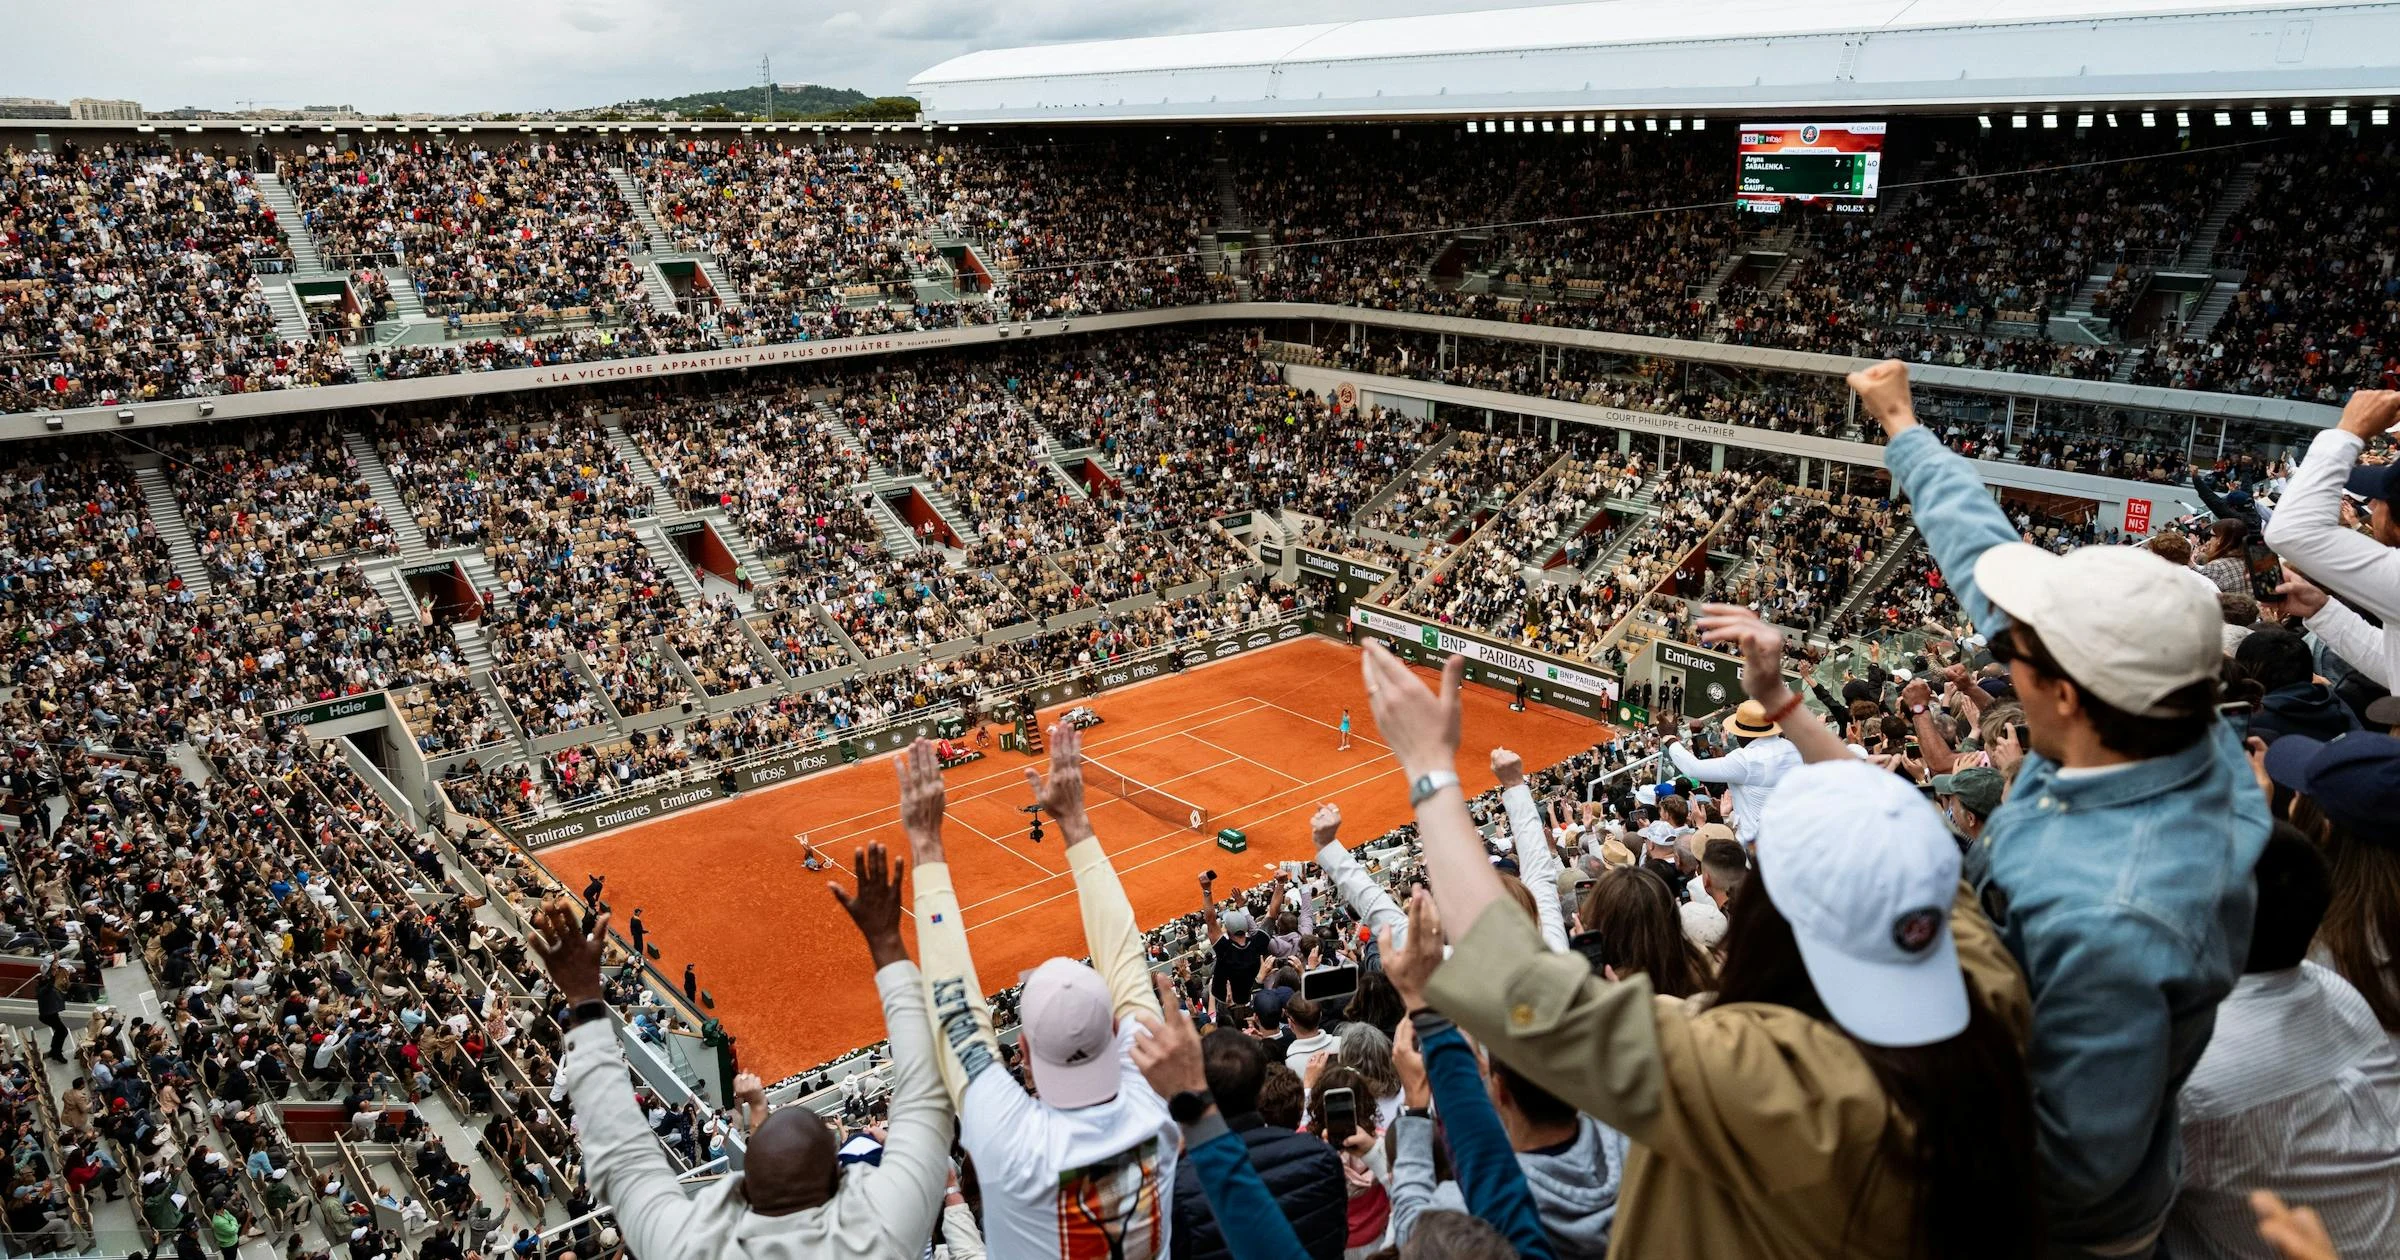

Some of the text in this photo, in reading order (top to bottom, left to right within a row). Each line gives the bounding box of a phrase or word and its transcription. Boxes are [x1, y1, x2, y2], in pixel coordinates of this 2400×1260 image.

[1835, 160, 1840, 168] 7
[1844, 182, 1849, 190] 6
[1855, 182, 1861, 190] 5
[1836, 204, 1865, 212] ROLEX
[552, 373, 570, 382] LA
[578, 364, 653, 379] VICTOIRE
[661, 354, 751, 371] APPARTIENT
[758, 352, 775, 361] AU
[783, 348, 814, 359] PLUS
[821, 341, 891, 355] OPINIÂTRE
[1606, 411, 1636, 423] COURT
[1638, 416, 1680, 430] PHILIPPE
[1687, 423, 1735, 438] CHATRIER
[2130, 503, 2147, 514] TEN
[2128, 519, 2145, 530] NIS
[419, 563, 450, 573] PARIBAS
[1305, 553, 1340, 572] Emirates
[1349, 565, 1385, 583] Emirates
[1382, 619, 1407, 632] PARIBAS
[1441, 635, 1535, 674] BNP PARIBAS
[1665, 648, 1716, 673] Emirates
[1101, 671, 1128, 687] Infosys
[1132, 663, 1159, 678] Infosys
[1486, 672, 1518, 686] BNP PARIBA
[1560, 670, 1575, 680] BNP
[1575, 674, 1605, 689] PARIBAS
[1553, 691, 1590, 708] BNP PARIBAS
[290, 711, 315, 724] aier
[329, 701, 367, 717] Haier
[793, 754, 828, 772] Infosys
[751, 765, 787, 784] Infosys
[659, 786, 713, 810] Emirates
[595, 803, 651, 828] Emirates
[525, 822, 584, 847] Emirates
[933, 976, 979, 1048] VALLEY
